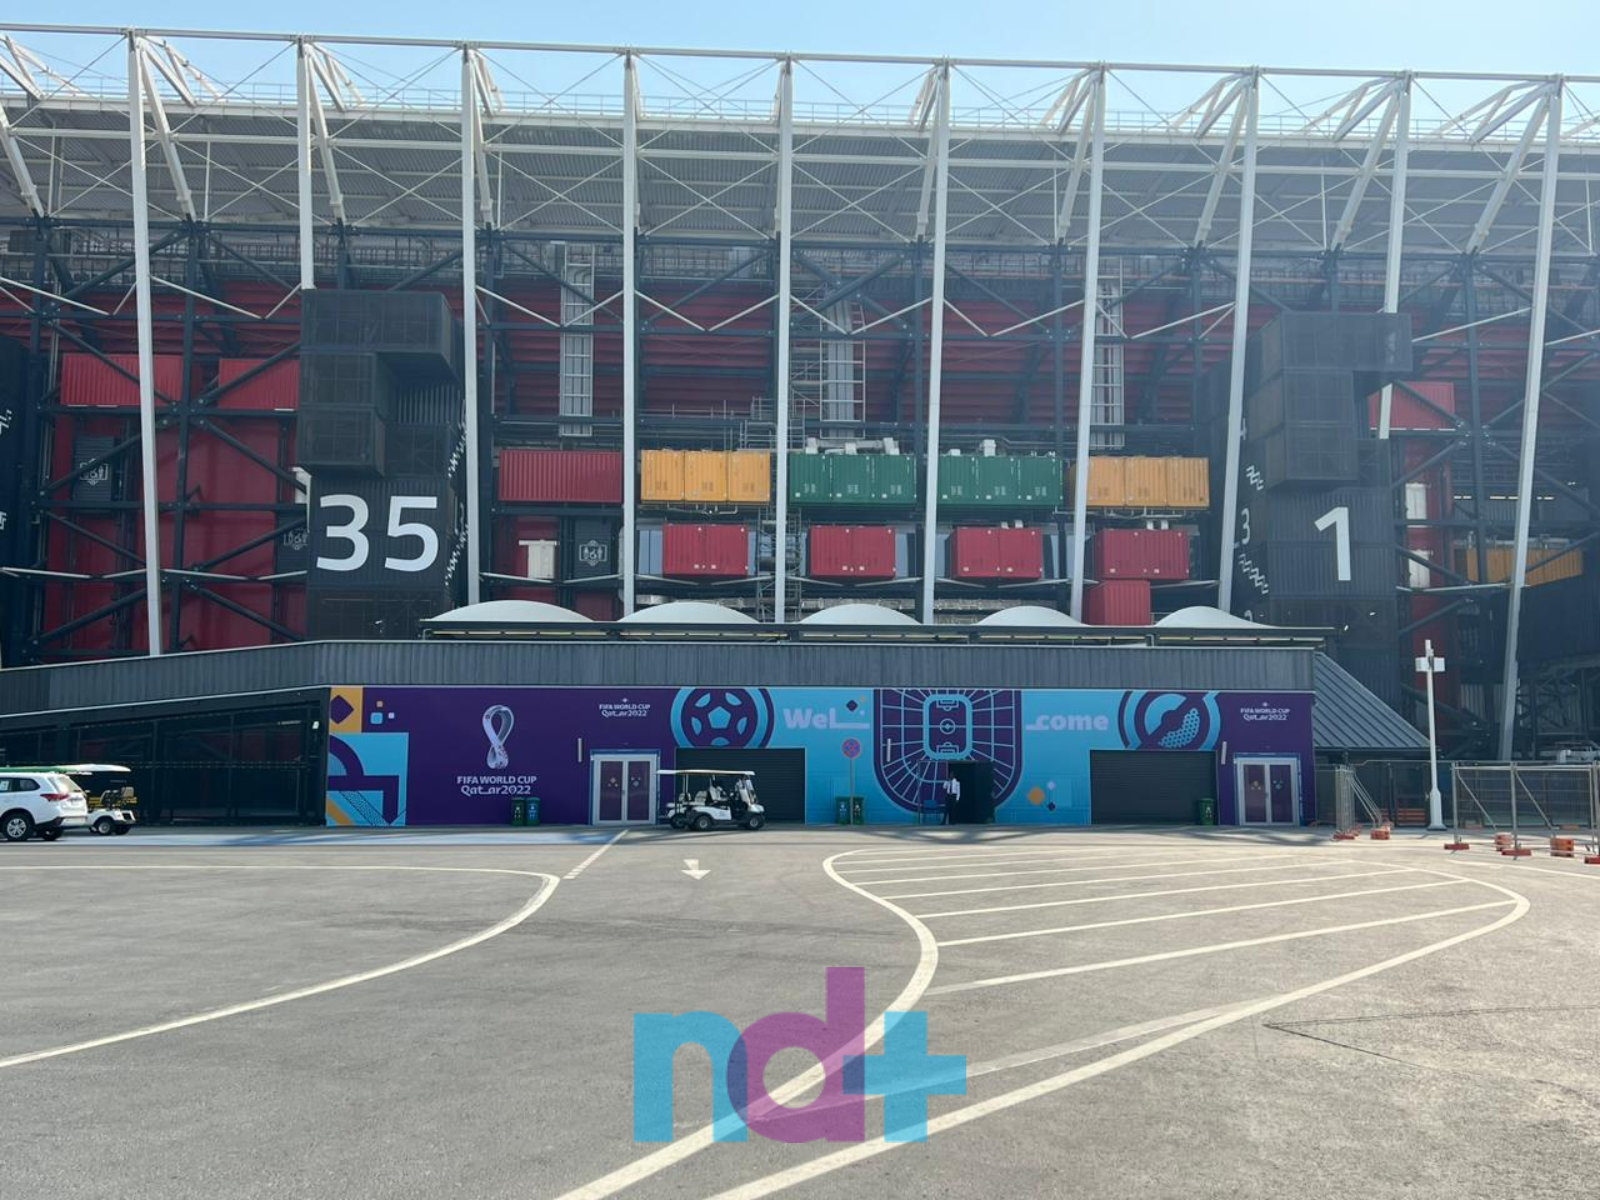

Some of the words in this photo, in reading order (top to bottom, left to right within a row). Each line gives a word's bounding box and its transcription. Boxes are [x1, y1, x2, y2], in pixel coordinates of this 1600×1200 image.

[316, 494, 439, 572] 35
[1314, 506, 1351, 581] 1
[457, 776, 479, 784] FIFA
[480, 776, 516, 784] WORLD
[517, 776, 537, 784] CUP
